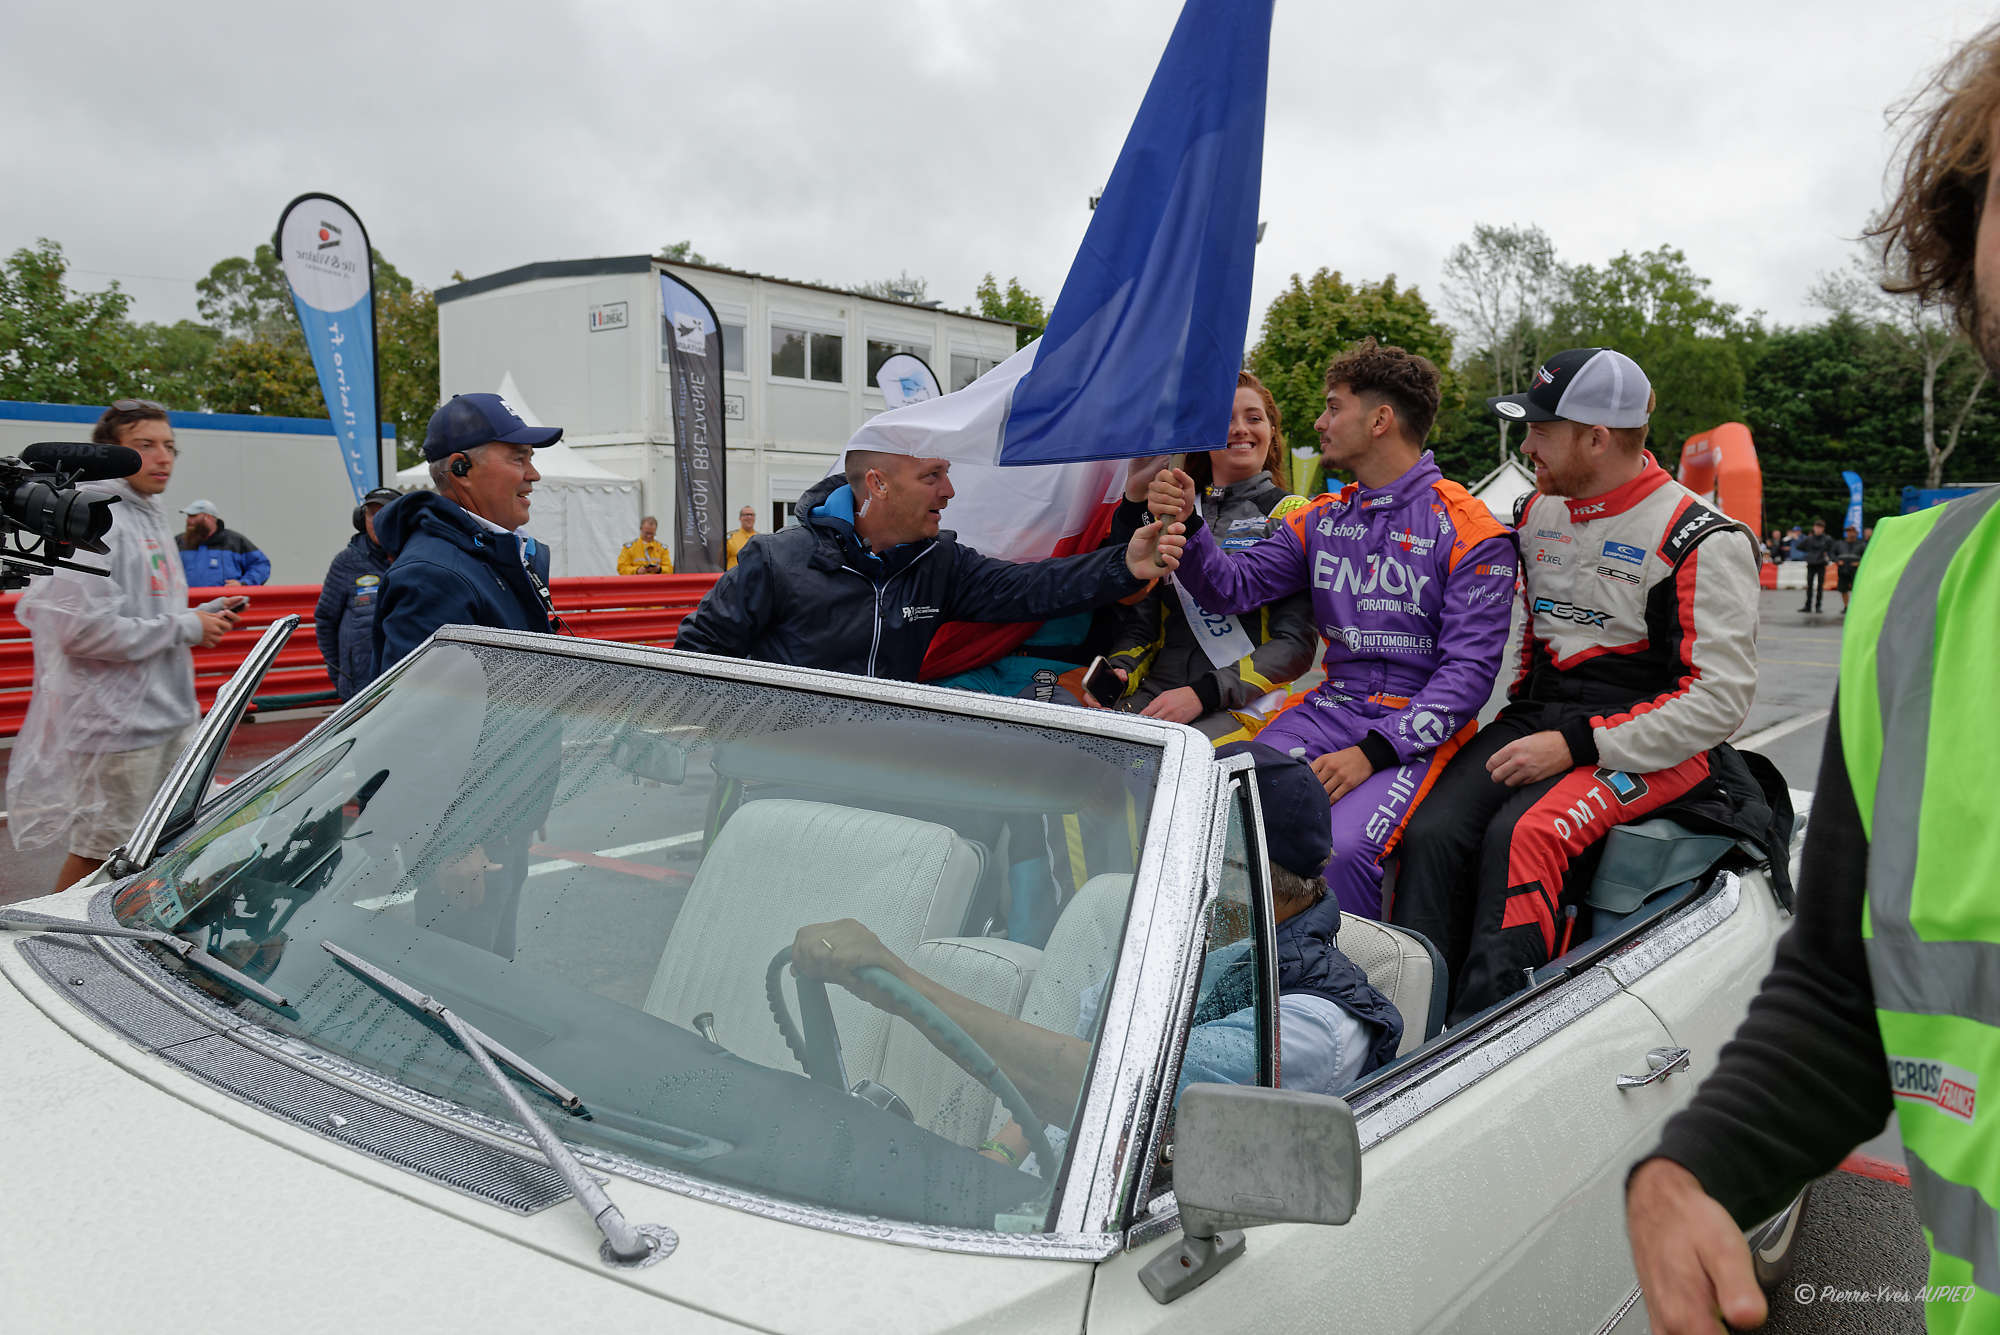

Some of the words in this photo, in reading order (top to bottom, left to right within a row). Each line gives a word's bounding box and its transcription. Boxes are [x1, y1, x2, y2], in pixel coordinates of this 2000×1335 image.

[1671, 511, 1715, 549] HRX
[1313, 549, 1431, 606] ENJOY
[1356, 598, 1402, 612] HYDRATION
[1362, 633, 1433, 649] AUTOMOBILES
[1888, 1060, 1942, 1094] CROS
